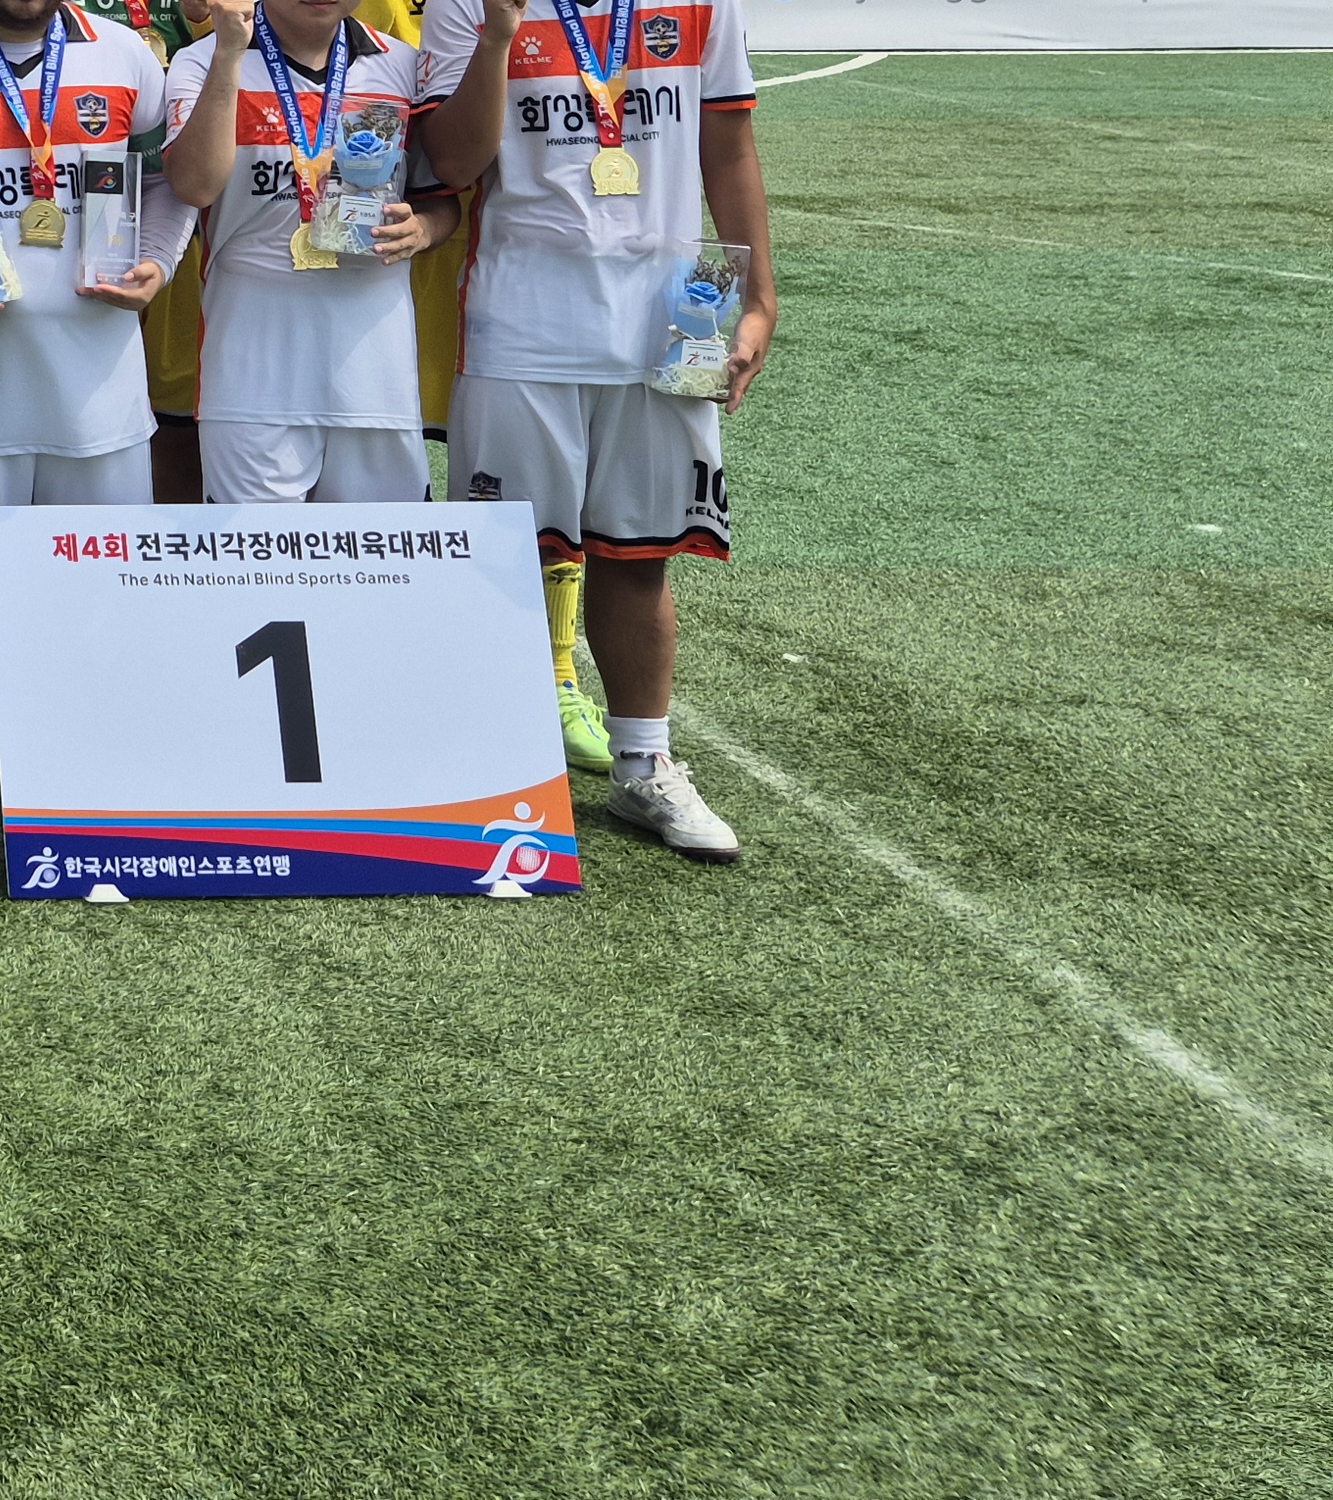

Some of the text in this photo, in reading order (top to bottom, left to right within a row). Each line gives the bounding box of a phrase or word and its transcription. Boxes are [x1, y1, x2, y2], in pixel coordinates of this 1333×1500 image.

[259, 24, 279, 62] Sports
[565, 18, 593, 74] National
[46, 48, 61, 76] Blind
[515, 56, 552, 65] KELME
[271, 62, 290, 92] Blind
[41, 76, 57, 122] National
[597, 93, 611, 118] The
[281, 92, 304, 145] National
[641, 131, 660, 142] CITY
[301, 167, 311, 192] The
[693, 459, 728, 514] 10
[52, 529, 472, 564] 제4회 전국시각장애인체육대제전
[118, 570, 411, 588] The 4th National Blind Sports Games
[235, 620, 323, 784] 1
[64, 853, 291, 880] 한국시각장애인스포츠연맹
